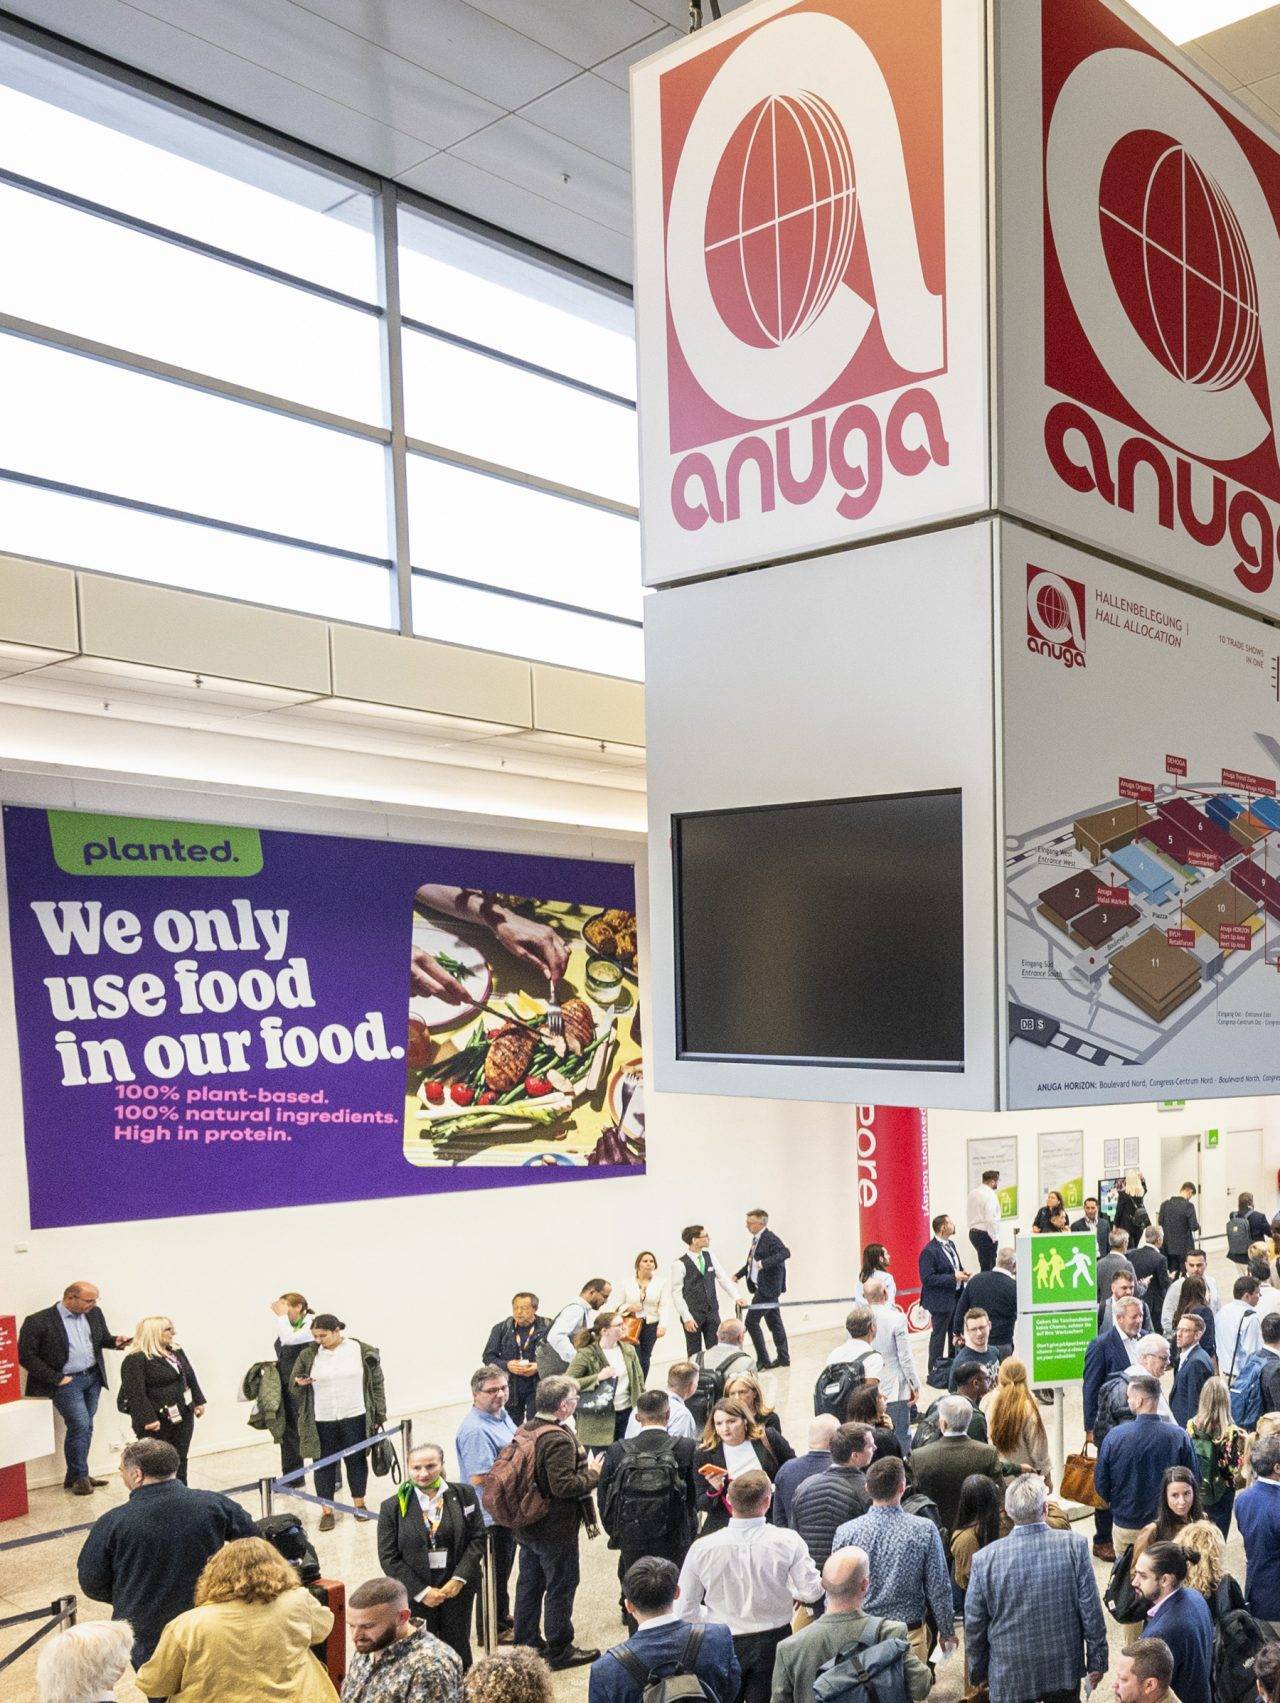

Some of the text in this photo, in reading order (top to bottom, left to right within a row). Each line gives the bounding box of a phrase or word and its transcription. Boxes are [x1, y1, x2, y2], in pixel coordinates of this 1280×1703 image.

[670, 387, 950, 532] anuga
[1095, 589, 1183, 631] HALLENBELEGUNG
[1095, 608, 1182, 648] HALL ALLOCATION
[1027, 636, 1086, 668] anuga
[1218, 634, 1265, 657] 10 TRADE SHOWS
[1246, 656, 1265, 669] IN ONE
[83, 837, 240, 865] planted.
[1038, 856, 1062, 866] Entrance
[1074, 887, 1081, 899] 2
[1101, 912, 1109, 924] 3
[1152, 911, 1169, 920] Piazza
[1217, 903, 1226, 913] 10
[30, 899, 290, 961] We only
[1021, 959, 1043, 970] Eingang
[1021, 968, 1046, 977] Entrance
[1151, 958, 1160, 968] 11
[43, 958, 316, 1022] use food
[1021, 1019, 1044, 1030] DB S
[55, 1012, 405, 1087] in our food.
[1037, 1082, 1062, 1092] ANUGA
[1064, 1081, 1097, 1091] HORIZON:
[1099, 1079, 1130, 1089] Boulevard
[1131, 1078, 1148, 1088] Nord,
[1149, 1076, 1199, 1087] Congress-Centrum
[1200, 1076, 1214, 1086] Nord
[1218, 1075, 1244, 1084] Boulevard
[115, 1084, 329, 1107] 100% plant-based.
[115, 1105, 399, 1126] 100% natural ingredients.
[115, 1125, 292, 1145] High in protein.
